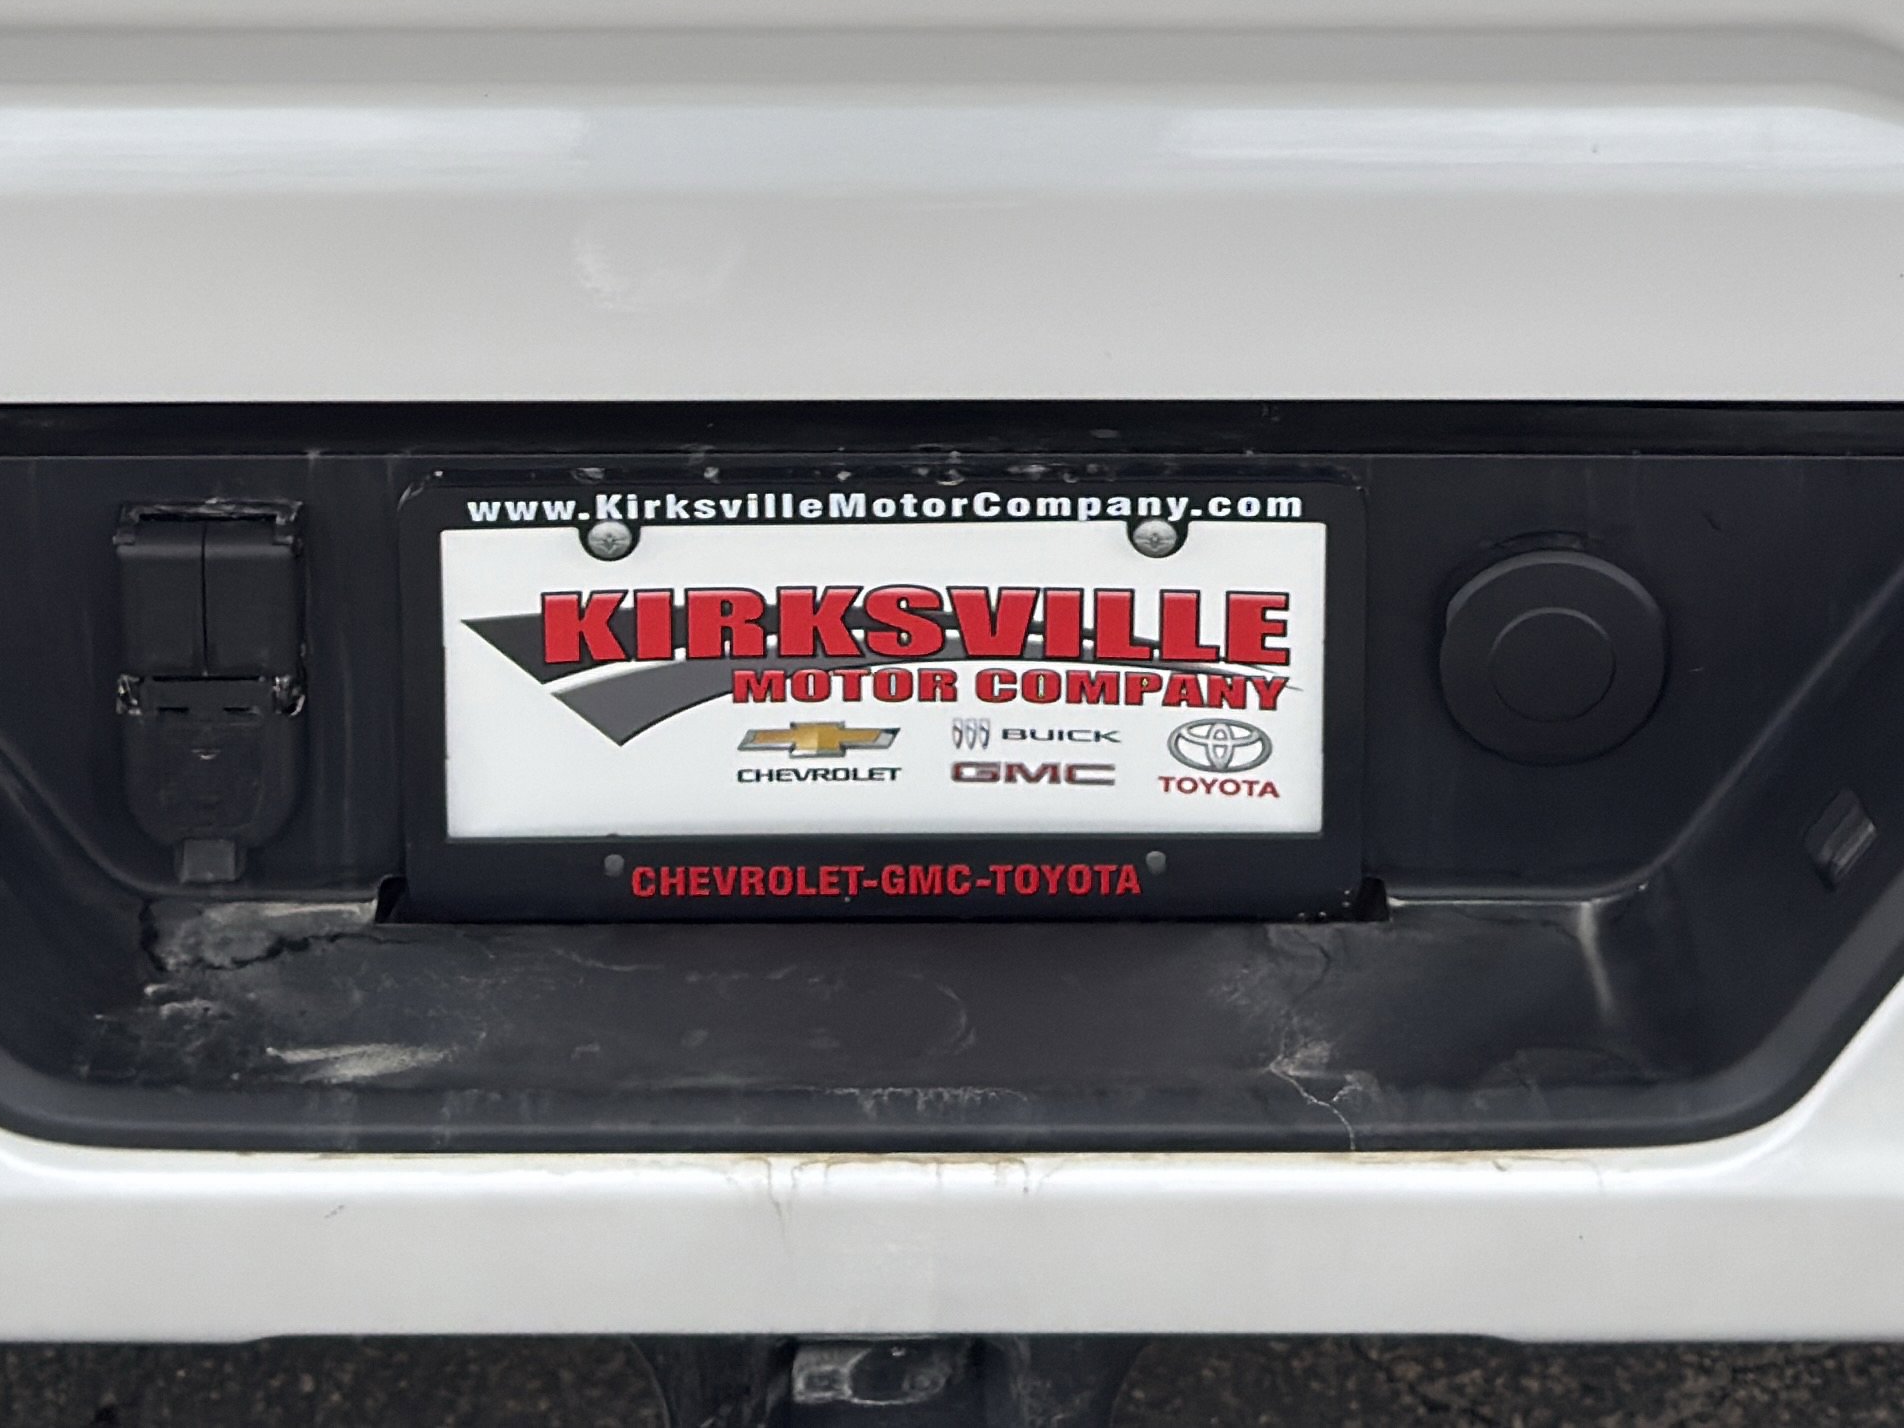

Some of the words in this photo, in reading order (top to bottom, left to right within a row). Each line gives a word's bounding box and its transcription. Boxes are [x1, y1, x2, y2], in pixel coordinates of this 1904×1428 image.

[467, 492, 1303, 521] www.KirksvilleMotorCompany.com
[540, 584, 1290, 665] KIRKSVILLE
[731, 668, 958, 704] MOTOR
[975, 668, 1289, 711] COMPANY
[1001, 729, 1121, 743] BUICK
[736, 767, 903, 783] CHEVROLET
[950, 760, 1116, 785] GMC
[1158, 775, 1281, 799] TOYOTA
[631, 864, 1141, 898] CHEVROLET-GMC-TOYOTA
